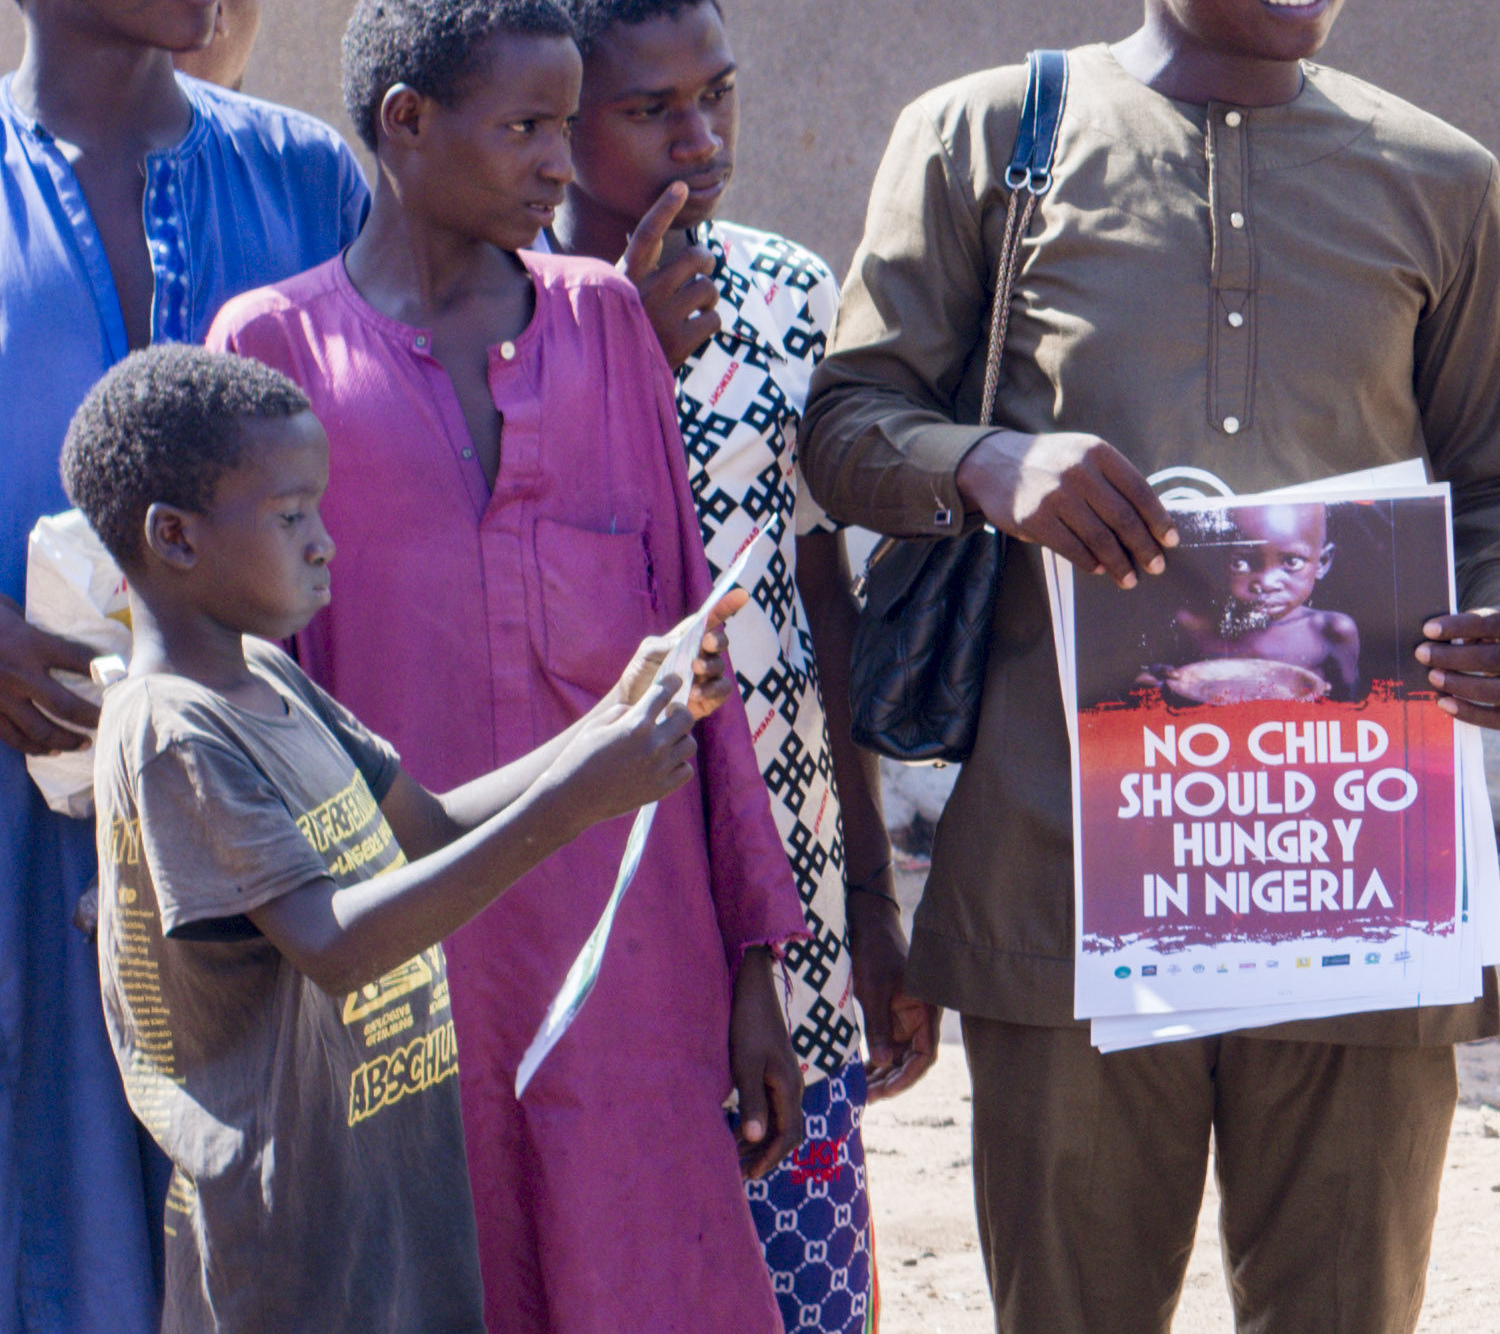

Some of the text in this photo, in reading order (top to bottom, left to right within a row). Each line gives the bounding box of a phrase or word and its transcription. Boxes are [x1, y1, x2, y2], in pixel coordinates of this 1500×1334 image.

[1144, 720, 1389, 767] NO CHILD
[1118, 767, 1418, 819] SHOULD GO
[1173, 818, 1362, 866] HUNGRY
[1144, 867, 1394, 917] IN NIGERIA
[791, 1166, 843, 1184] SPORT
